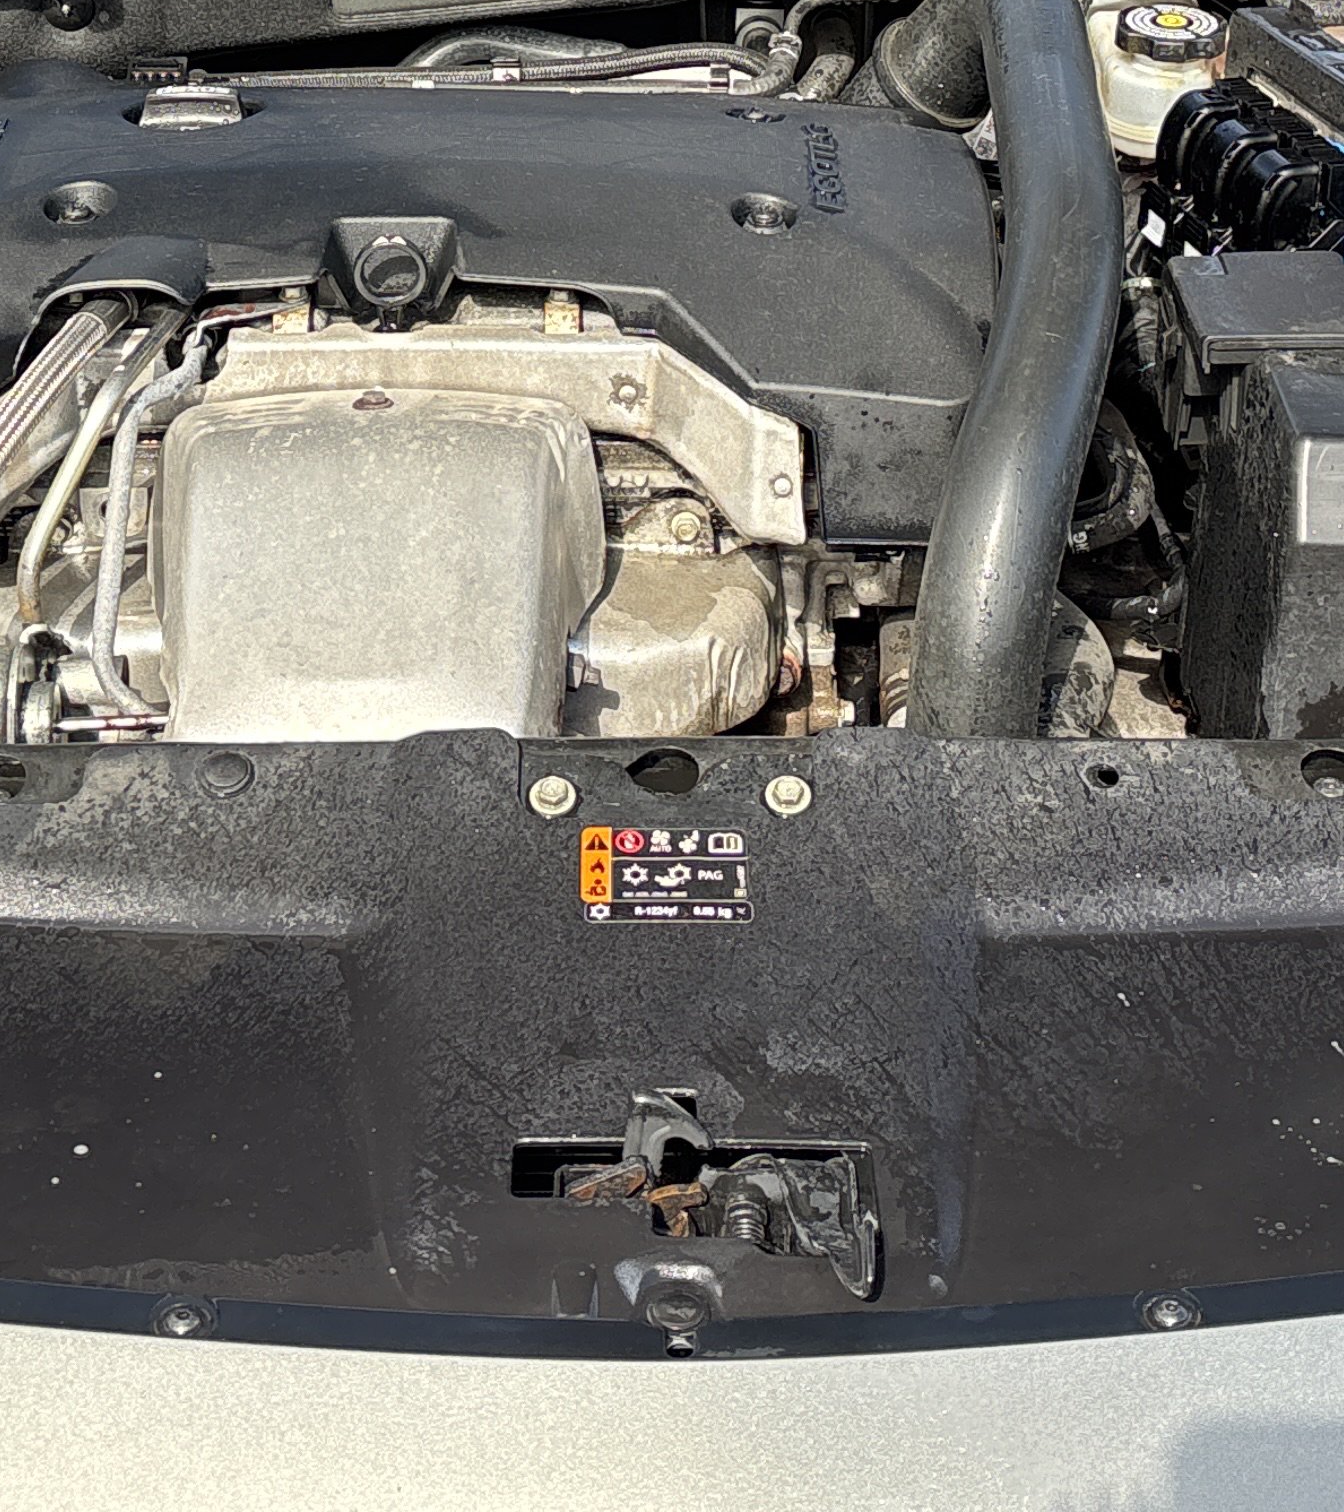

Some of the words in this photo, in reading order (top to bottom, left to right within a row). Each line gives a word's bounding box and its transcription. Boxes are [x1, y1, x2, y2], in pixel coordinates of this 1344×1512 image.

[649, 845, 672, 853] AUTO
[697, 870, 723, 880] PAG
[718, 907, 733, 919] kg
